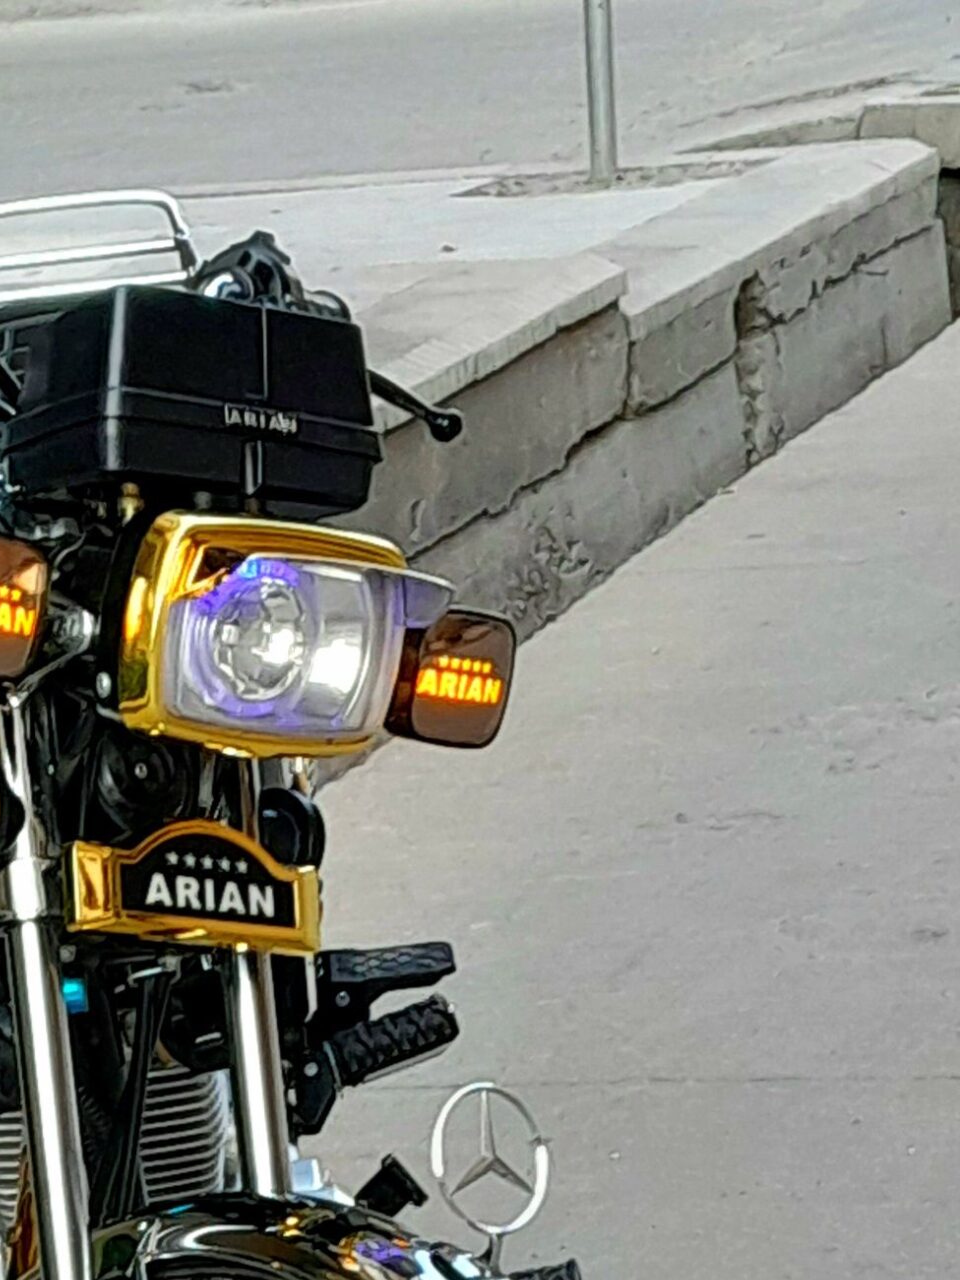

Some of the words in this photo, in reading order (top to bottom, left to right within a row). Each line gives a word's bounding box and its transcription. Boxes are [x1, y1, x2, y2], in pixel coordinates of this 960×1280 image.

[227, 406, 298, 434] ARIAN
[416, 668, 502, 704] ARIAN
[145, 872, 276, 918] ARIAN
